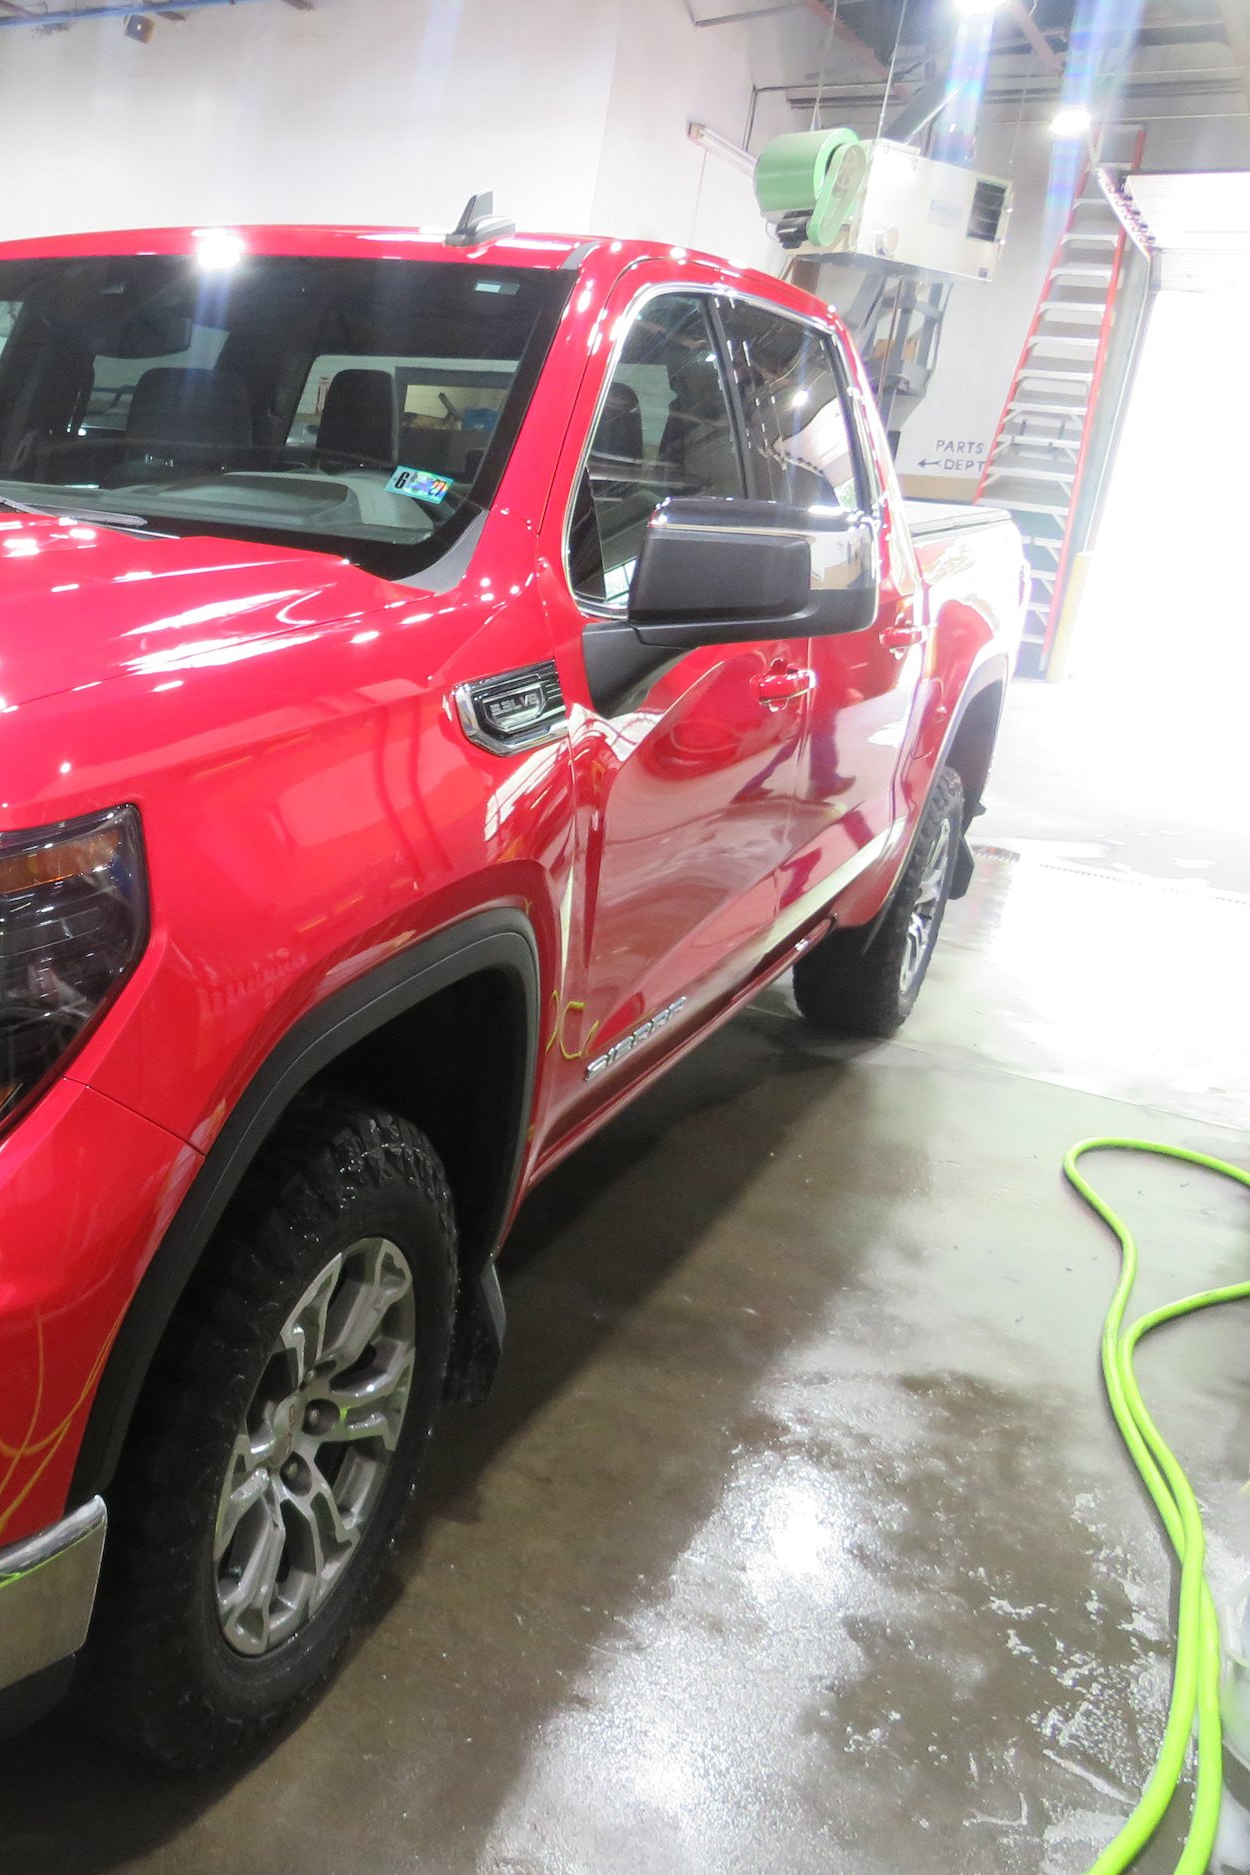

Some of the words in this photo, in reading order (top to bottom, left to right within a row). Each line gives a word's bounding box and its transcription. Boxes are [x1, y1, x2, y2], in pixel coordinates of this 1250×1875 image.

[936, 439, 984, 454] PARTS
[943, 458, 987, 472] DEPT
[585, 996, 687, 1081] SIERRA
